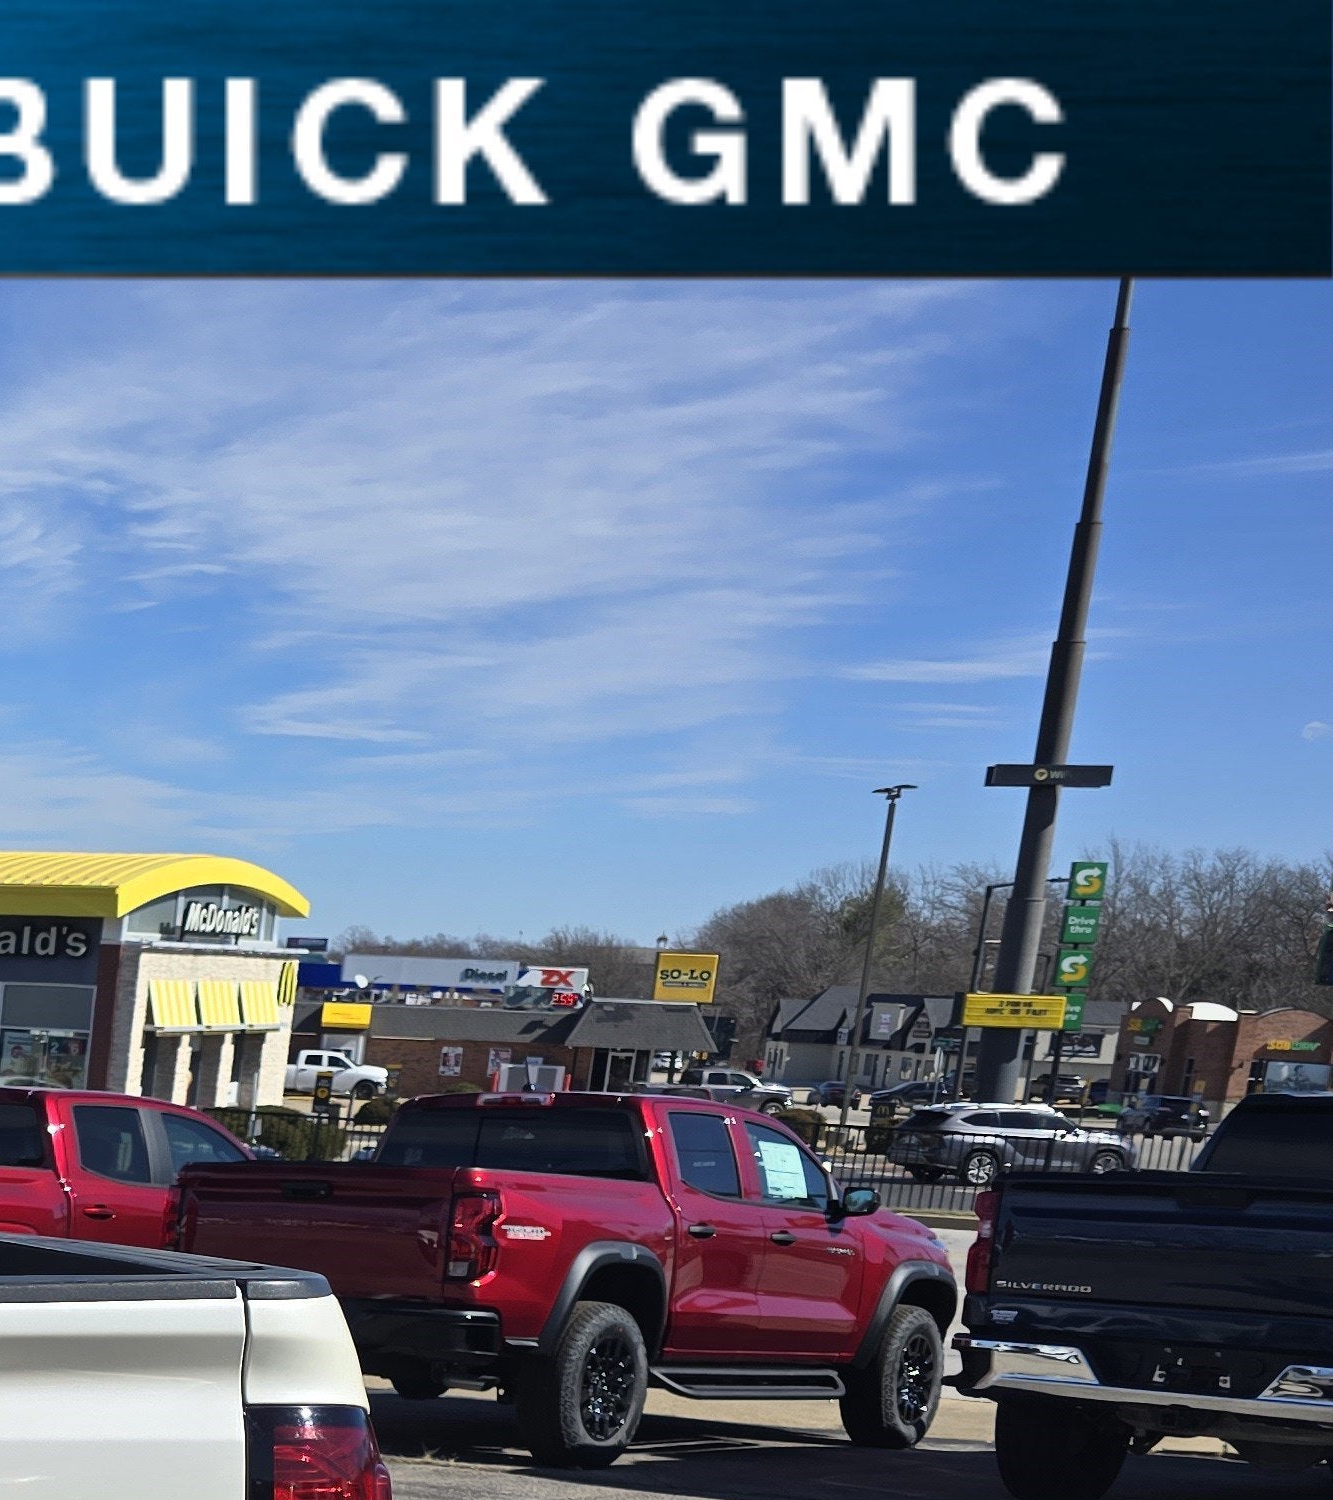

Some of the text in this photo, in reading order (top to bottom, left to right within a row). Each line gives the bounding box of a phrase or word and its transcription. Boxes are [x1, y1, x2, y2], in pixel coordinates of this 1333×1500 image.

[185, 902, 260, 935] McDonald's
[1068, 916, 1096, 925] Drive
[1070, 925, 1092, 934] thru
[463, 968, 508, 982] Diesel
[660, 969, 712, 981] SO-LO
[995, 1280, 1092, 1294] SILVERADO
